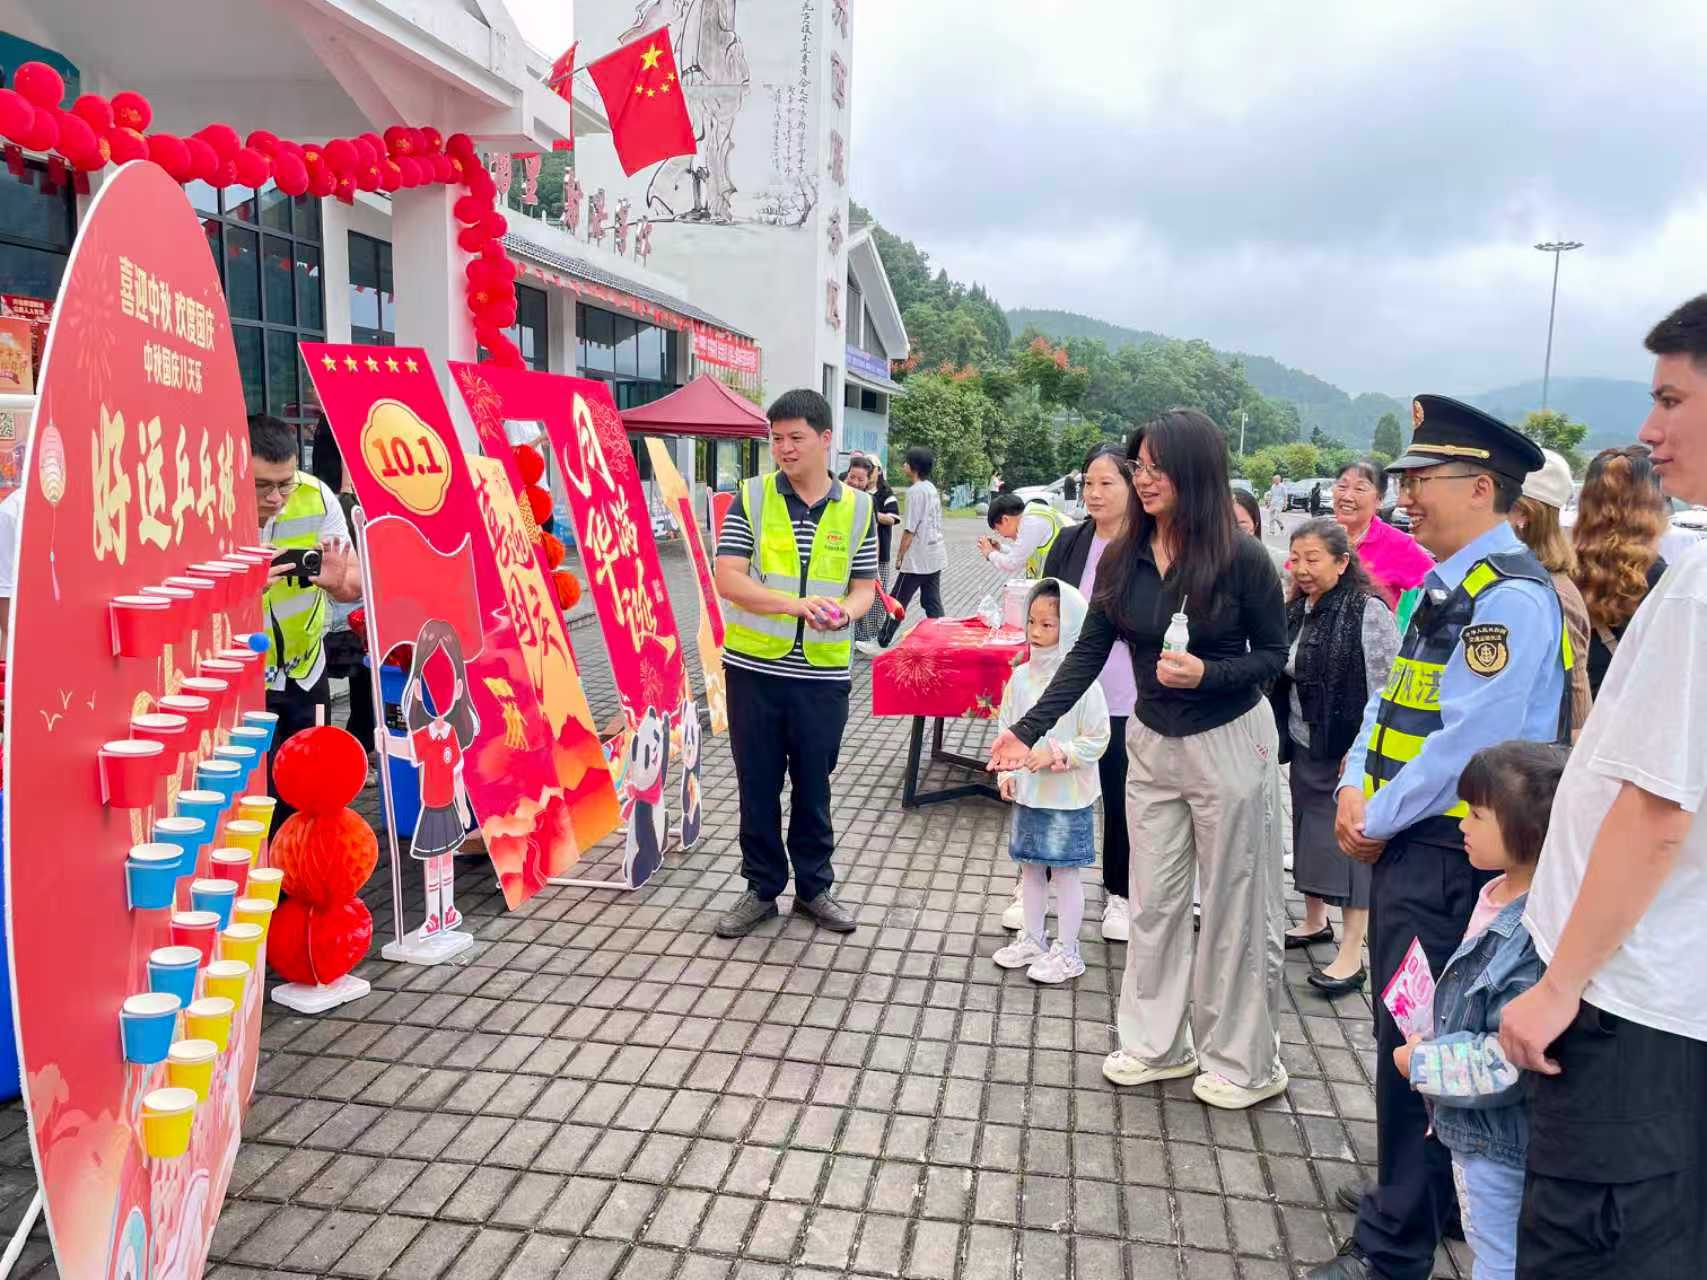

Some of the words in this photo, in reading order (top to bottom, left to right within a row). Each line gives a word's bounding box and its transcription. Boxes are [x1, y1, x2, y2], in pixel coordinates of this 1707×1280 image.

[119, 256, 173, 334] 喜迎中秋
[175, 290, 215, 352] 欢度国庆
[143, 339, 203, 394] 中秋国庆八天乐
[92, 402, 236, 566] 好运乒乓球
[372, 436, 443, 477] 10.1
